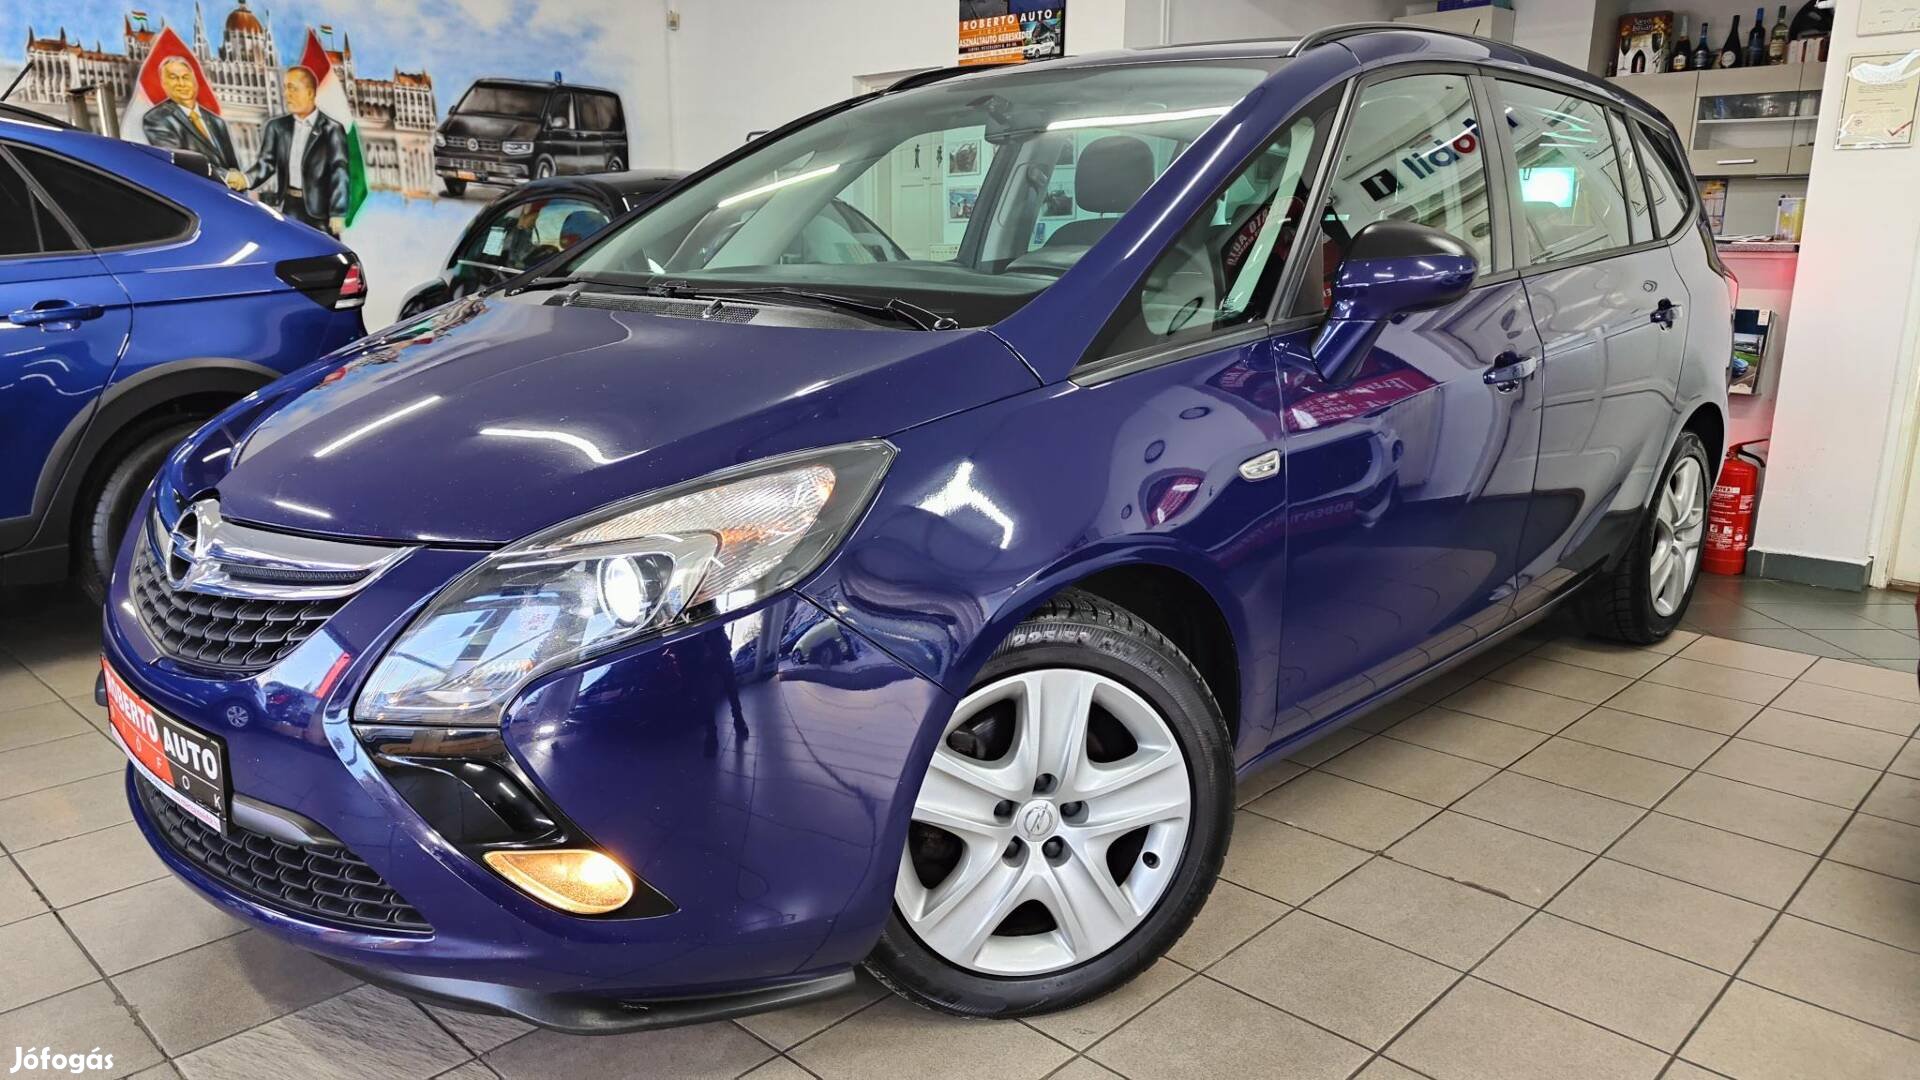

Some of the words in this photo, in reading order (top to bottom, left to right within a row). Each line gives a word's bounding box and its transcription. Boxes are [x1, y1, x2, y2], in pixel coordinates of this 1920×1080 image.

[963, 15, 1015, 31] ROBERTO
[1020, 9, 1053, 22] AUTO
[104, 667, 158, 743] ROBERTO
[163, 726, 218, 780] AUTO
